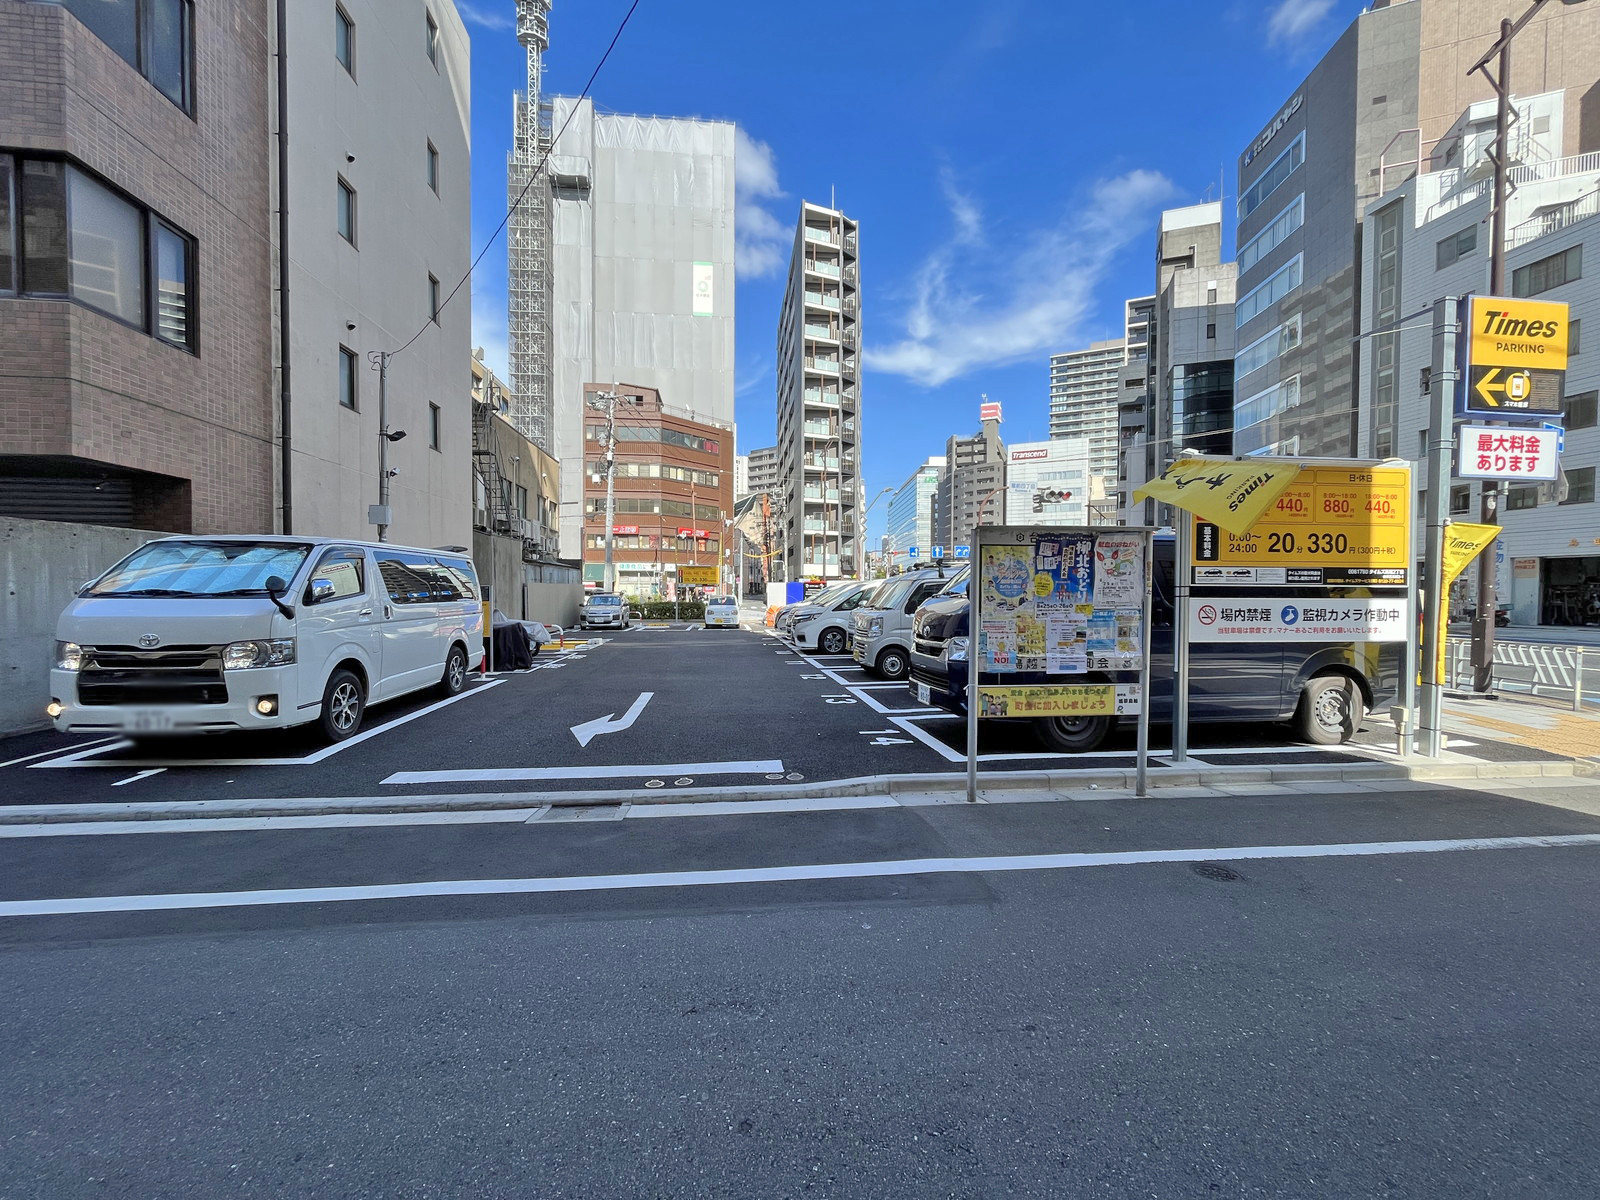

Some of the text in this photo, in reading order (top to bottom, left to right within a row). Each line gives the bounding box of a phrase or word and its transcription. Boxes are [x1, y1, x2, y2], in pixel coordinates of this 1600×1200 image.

[1483, 311, 1558, 338] Times
[1496, 342, 1544, 354] PARKING
[1477, 434, 1540, 454] 最大料金
[1012, 450, 1047, 459] Transcend
[1477, 454, 1540, 472] あります
[1228, 472, 1274, 512] Times
[1203, 527, 1212, 557] 基本料金
[1228, 544, 1257, 552] 24:00
[1076, 541, 1091, 602] 柳北おどり
[1221, 608, 1272, 622] 場内禁煙
[1302, 608, 1400, 622] 監視カメラ作動中
[821, 694, 857, 705] 13
[1014, 700, 1106, 710] 町会に加入しましょう
[859, 729, 914, 747] 14
